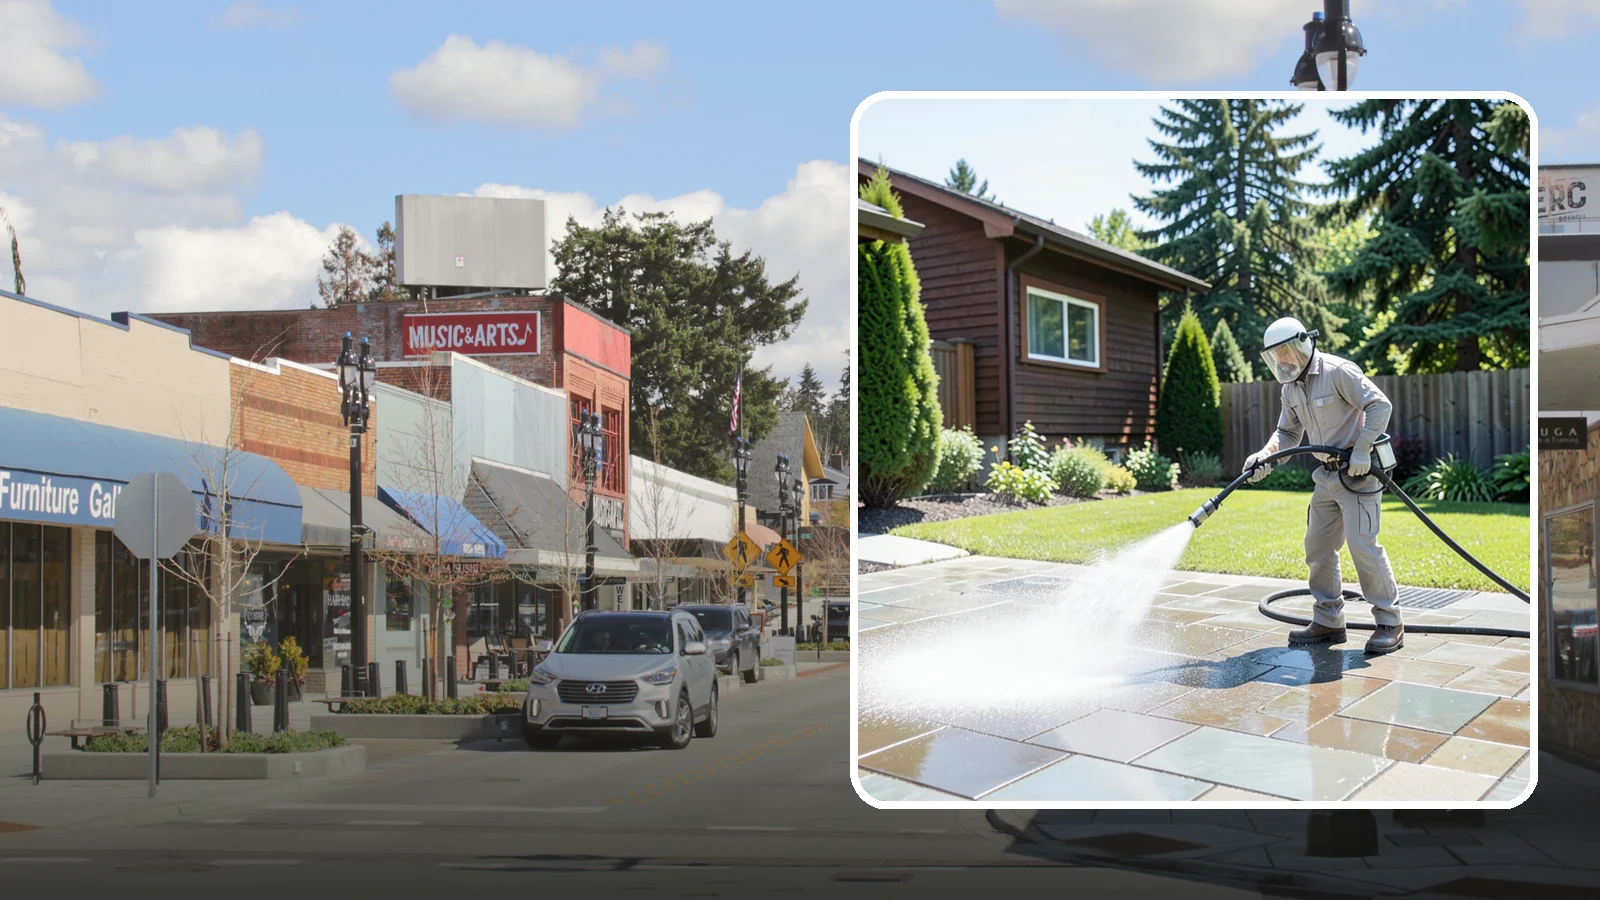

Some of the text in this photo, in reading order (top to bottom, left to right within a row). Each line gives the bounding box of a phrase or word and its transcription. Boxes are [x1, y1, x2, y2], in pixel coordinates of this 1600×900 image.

[1540, 427, 1577, 437] UGA
[0, 471, 122, 519] Furniture Gal
